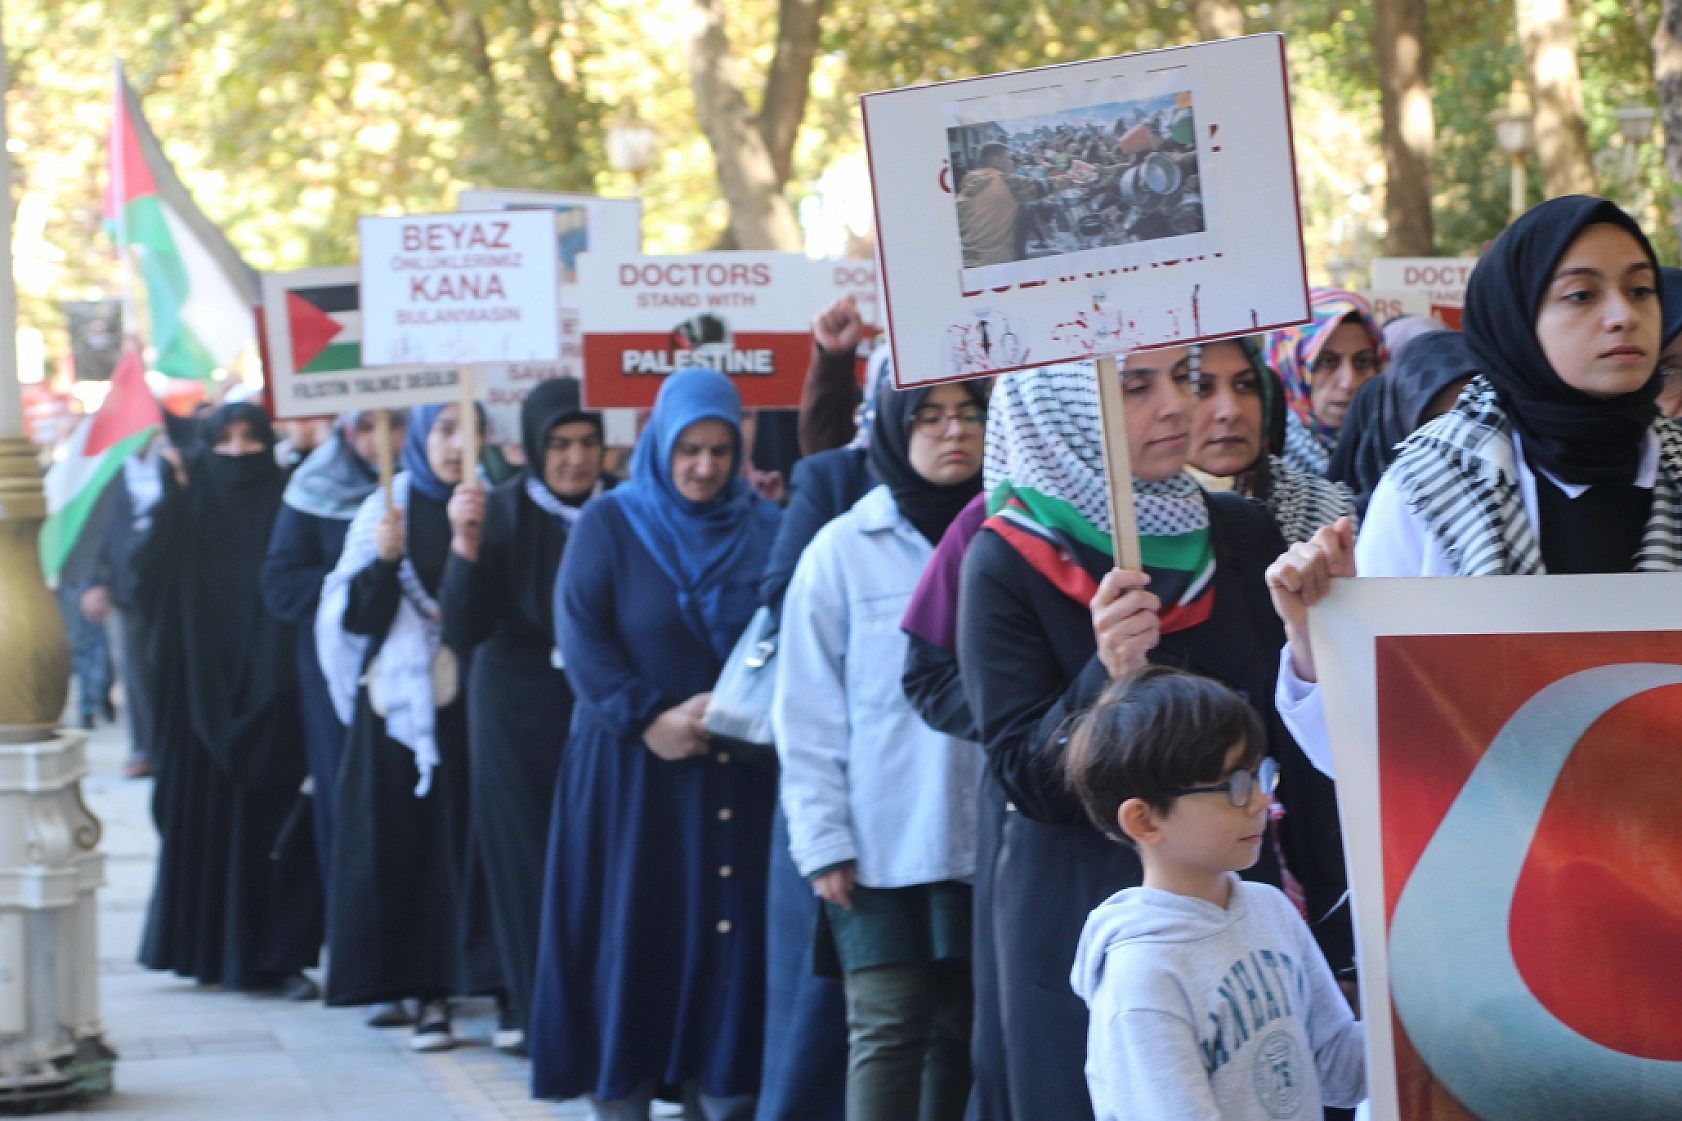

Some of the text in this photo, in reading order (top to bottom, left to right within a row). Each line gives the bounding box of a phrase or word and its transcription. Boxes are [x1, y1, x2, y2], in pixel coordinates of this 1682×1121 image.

[402, 222, 511, 251] BEYAZ
[619, 264, 772, 286] DOCTORS
[1403, 266, 1470, 286] DOCT
[410, 273, 507, 301] KANA
[637, 293, 756, 308] STAND WITH
[621, 350, 775, 375] PALESTINE
